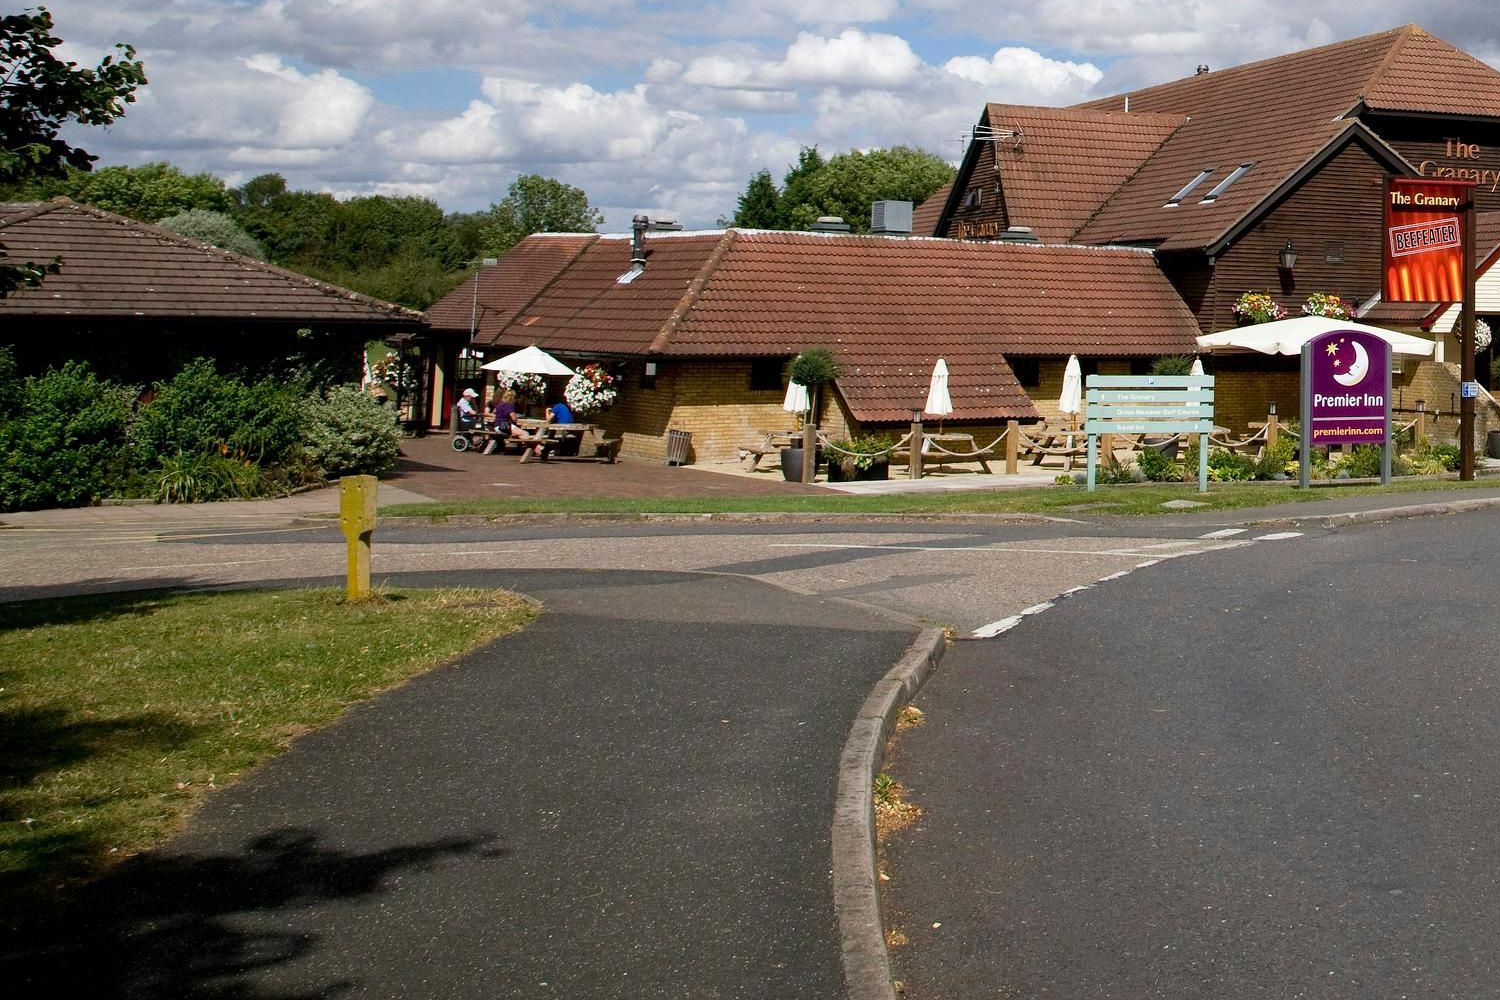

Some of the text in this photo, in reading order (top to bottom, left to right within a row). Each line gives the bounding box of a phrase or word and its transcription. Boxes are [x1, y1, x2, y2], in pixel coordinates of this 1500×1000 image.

[1443, 137, 1480, 159] The
[1390, 191, 1460, 210] The Granary
[1396, 225, 1457, 250] BEEFEATER
[1314, 393, 1383, 407] Premier Inn
[1313, 426, 1383, 438] premierinn.com
